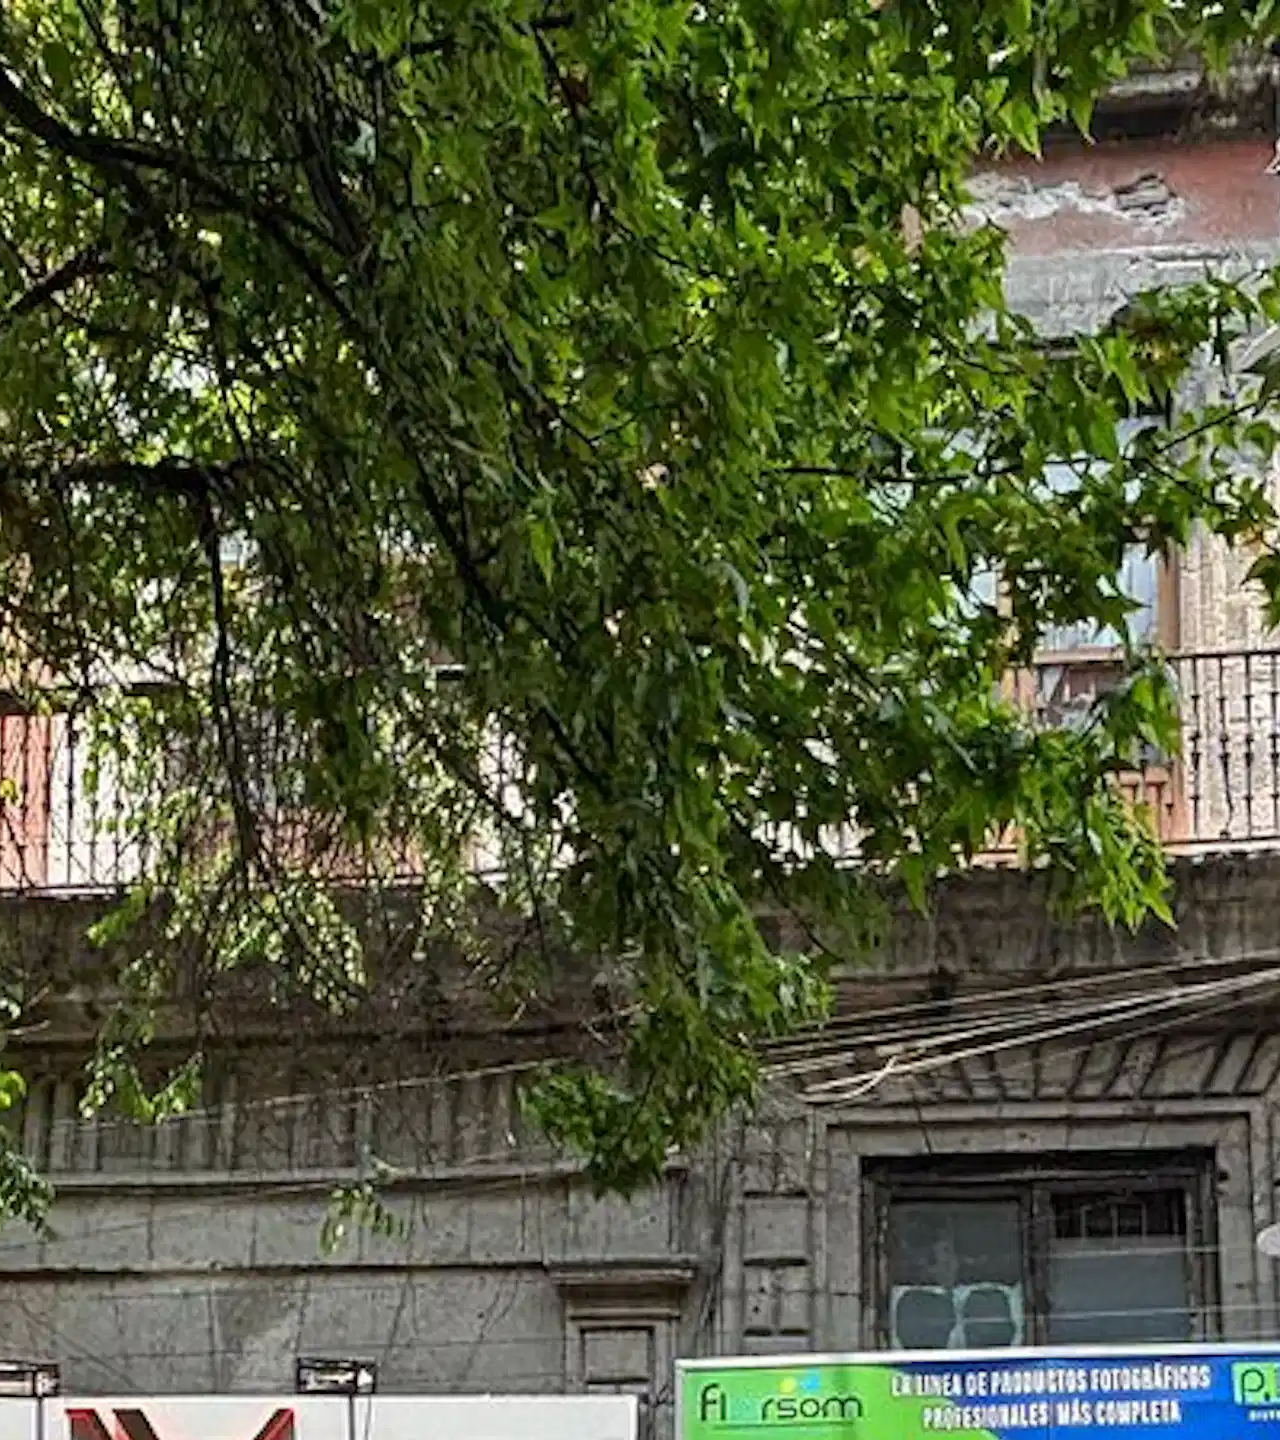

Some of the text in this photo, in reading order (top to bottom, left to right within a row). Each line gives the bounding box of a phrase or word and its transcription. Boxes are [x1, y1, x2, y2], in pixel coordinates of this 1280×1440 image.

[965, 1370, 988, 1396] DE
[990, 1366, 1087, 1395] PRODUCTOS
[1090, 1361, 1211, 1391] FOTOGRÁFICOS
[700, 1382, 863, 1421] flrsom
[923, 1402, 1049, 1430] PROFESIONALES
[1095, 1398, 1182, 1425] COMPLETA
